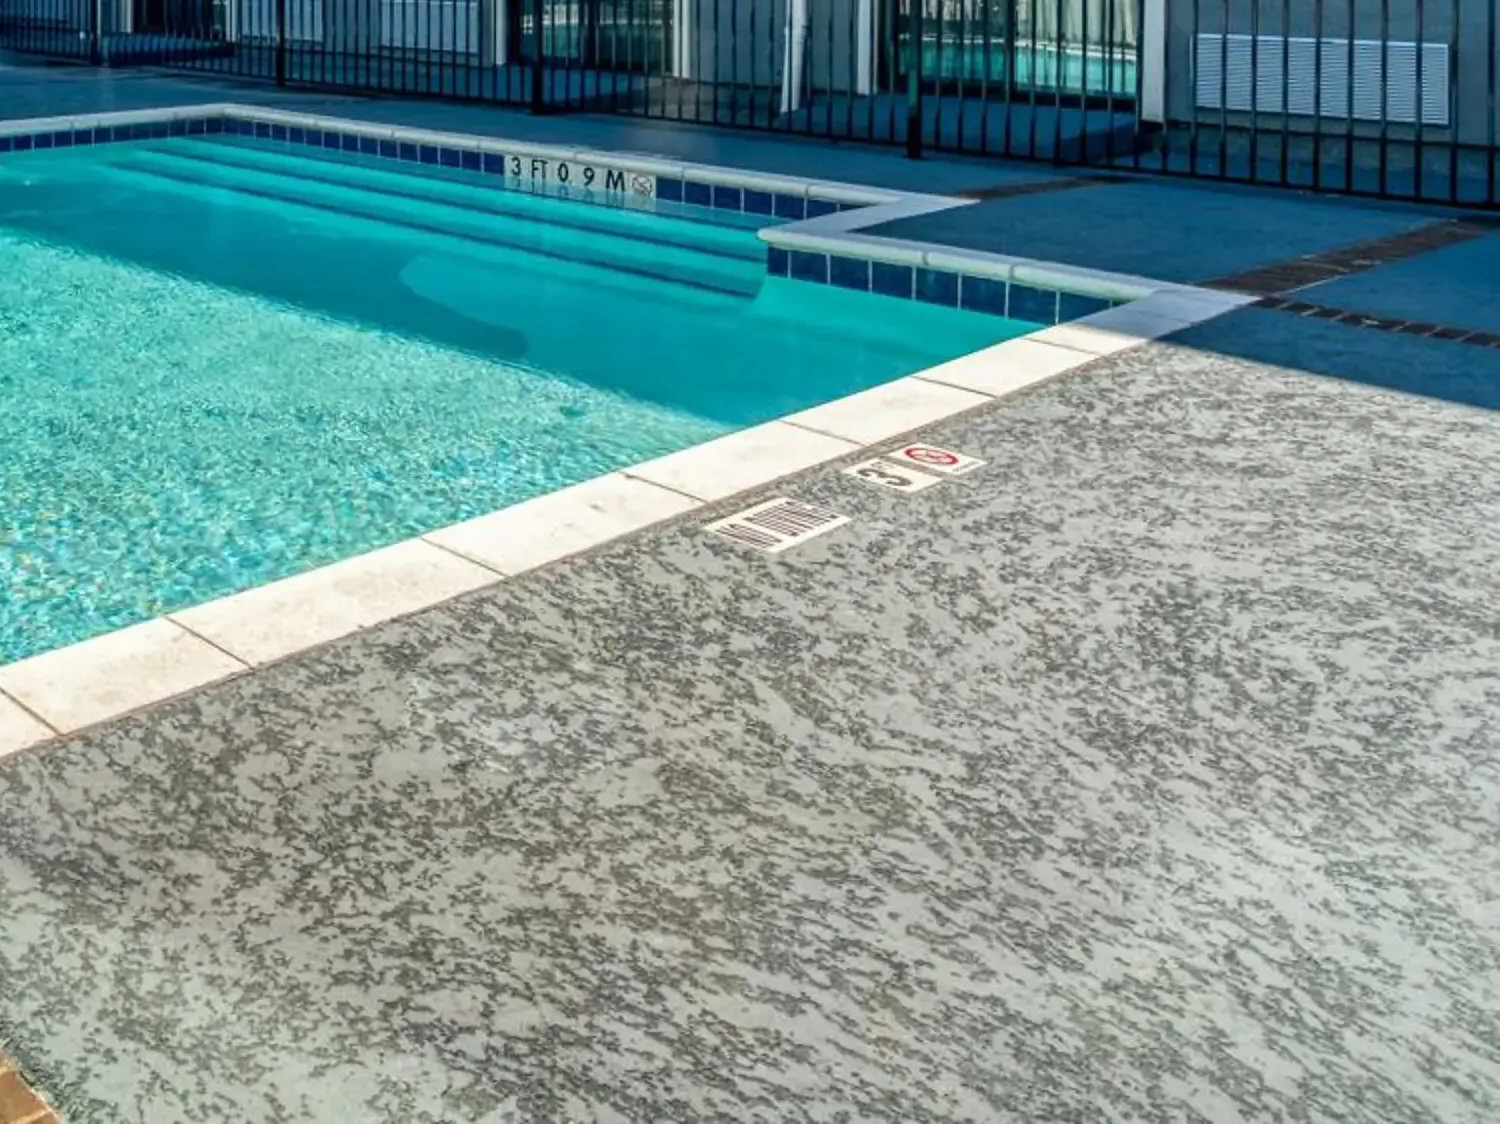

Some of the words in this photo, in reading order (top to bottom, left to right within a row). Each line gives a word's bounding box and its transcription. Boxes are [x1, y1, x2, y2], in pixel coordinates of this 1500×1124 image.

[510, 156, 521, 176] 3
[531, 159, 549, 179] FT
[605, 169, 626, 192] M
[855, 467, 913, 486] 3
